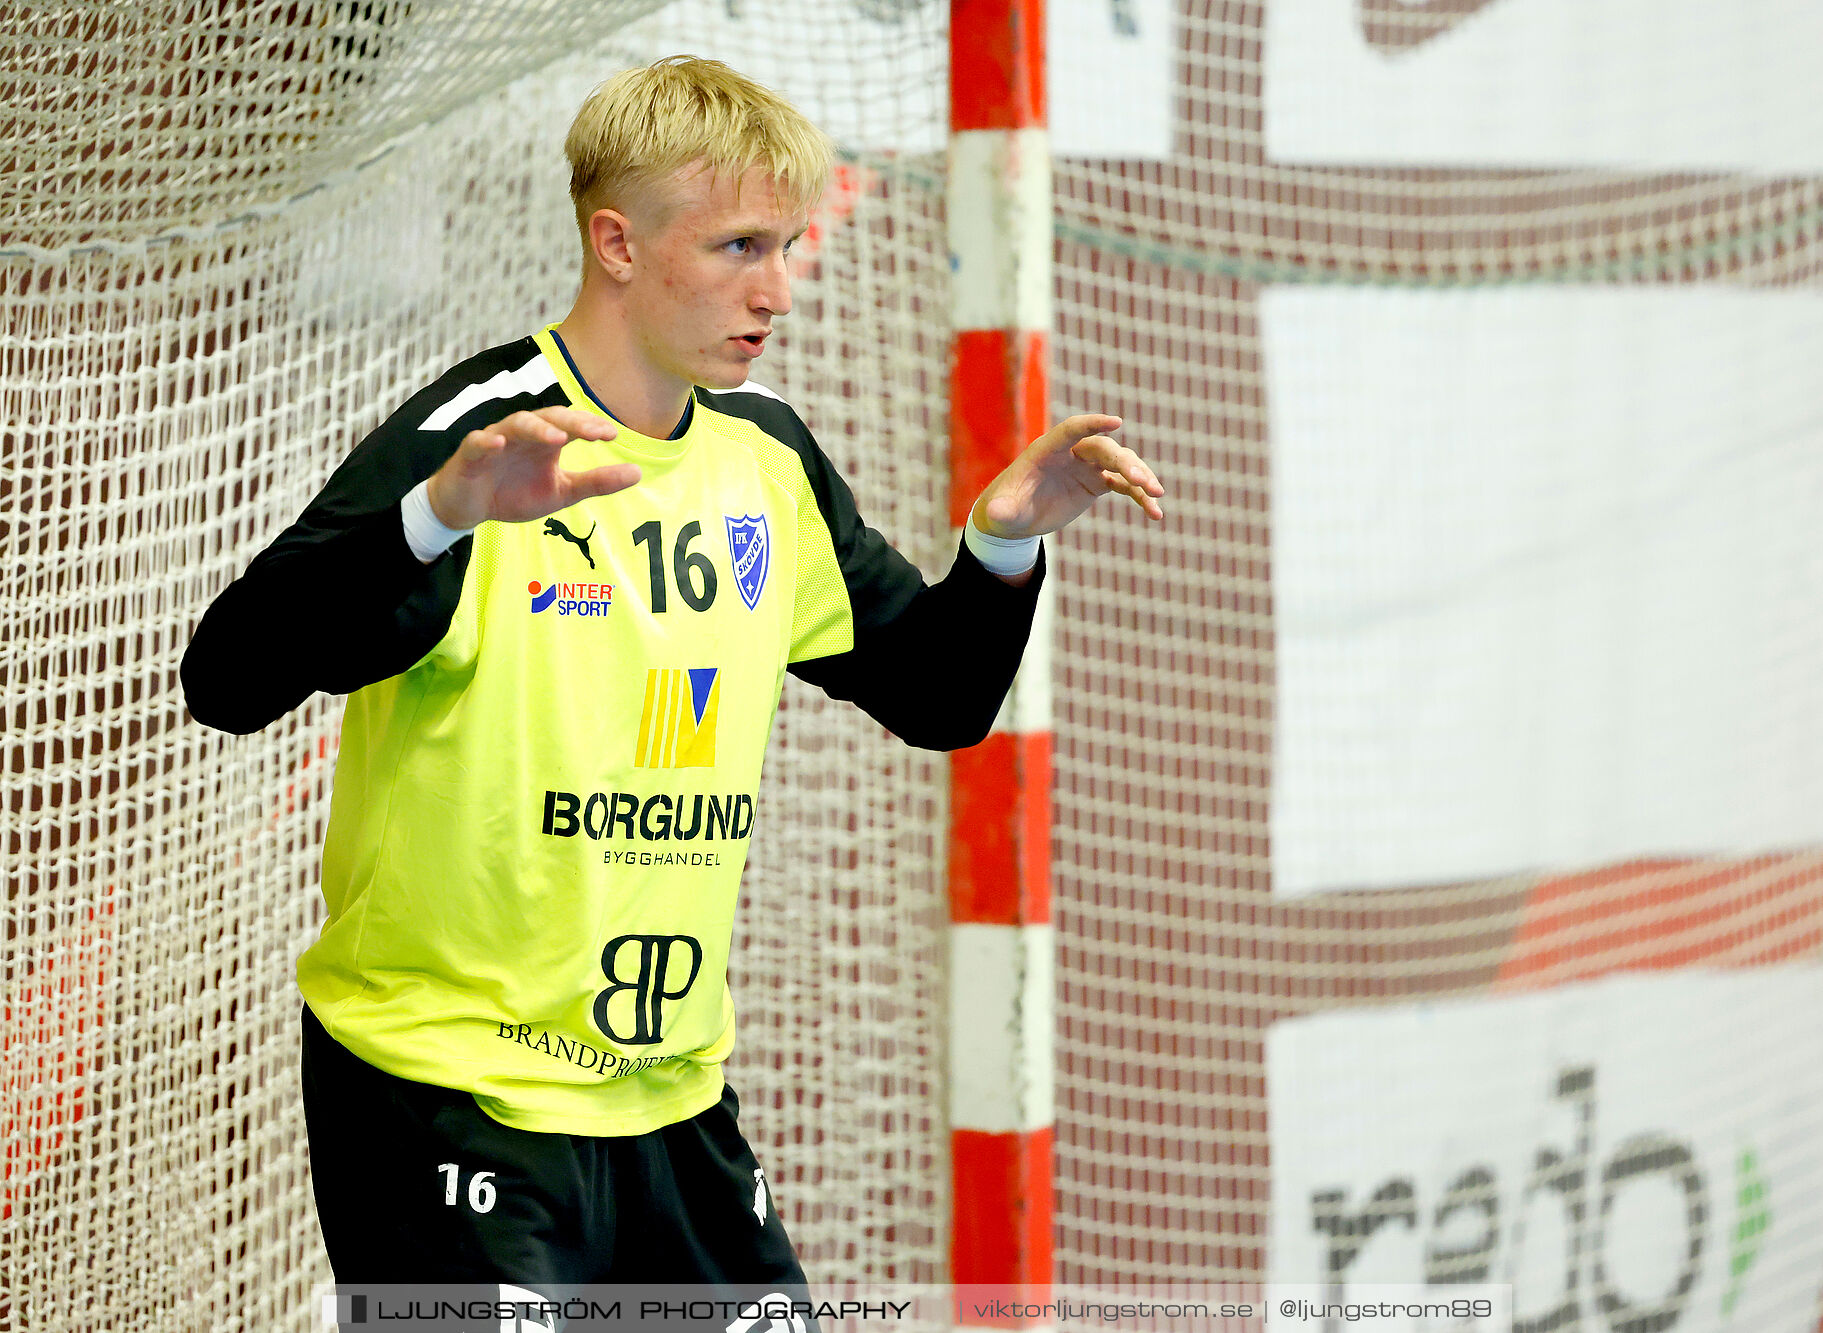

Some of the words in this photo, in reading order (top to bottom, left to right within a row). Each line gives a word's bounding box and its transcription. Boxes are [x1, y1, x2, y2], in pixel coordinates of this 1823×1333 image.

[632, 520, 718, 613] 16
[738, 533, 763, 576] SKÖVDE
[557, 583, 612, 600] INTER
[557, 600, 611, 616] SPORT
[541, 790, 759, 841] BORGUND
[603, 851, 721, 866] BYGGHANDEL
[437, 1162, 497, 1214] 16
